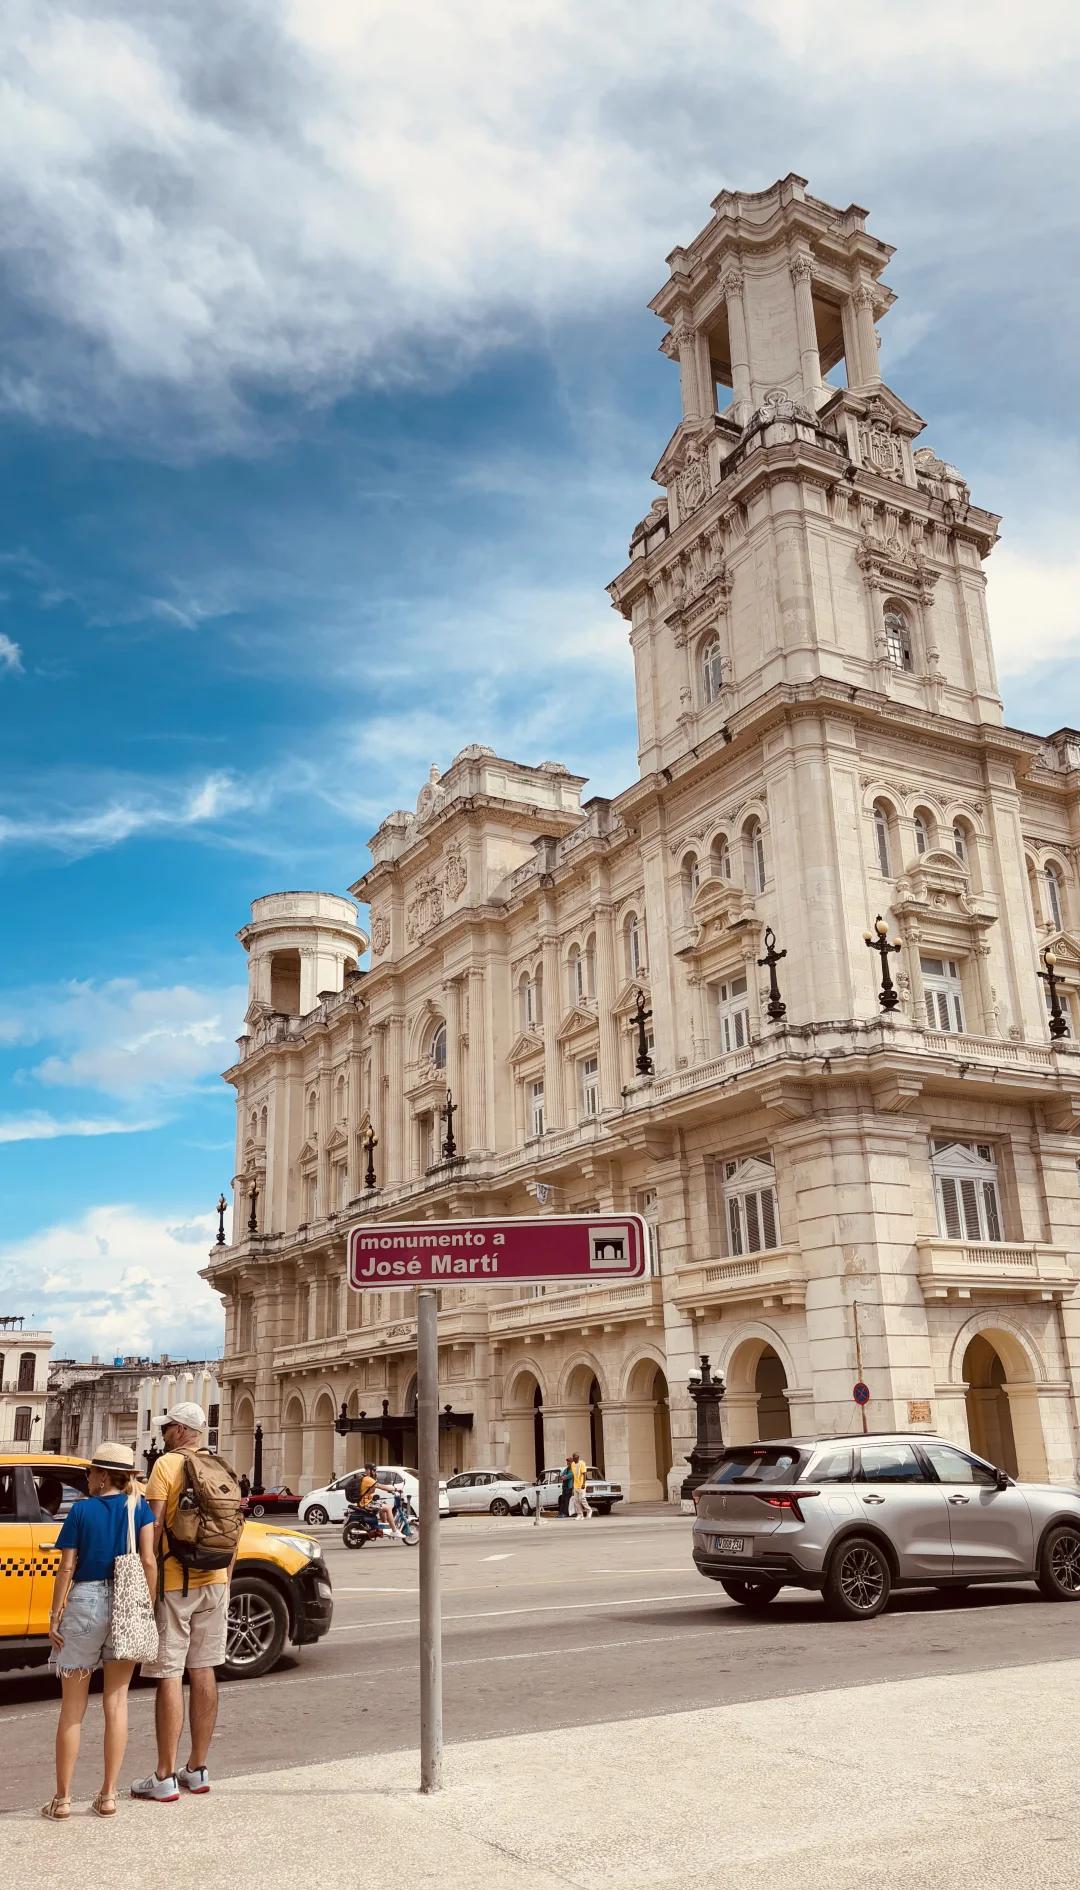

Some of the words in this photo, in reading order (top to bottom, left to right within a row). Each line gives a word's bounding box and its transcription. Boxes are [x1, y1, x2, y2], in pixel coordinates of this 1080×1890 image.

[361, 1231, 486, 1250] monumento
[493, 1233, 505, 1246] a
[361, 1256, 422, 1276] José
[431, 1253, 499, 1274] Martí
